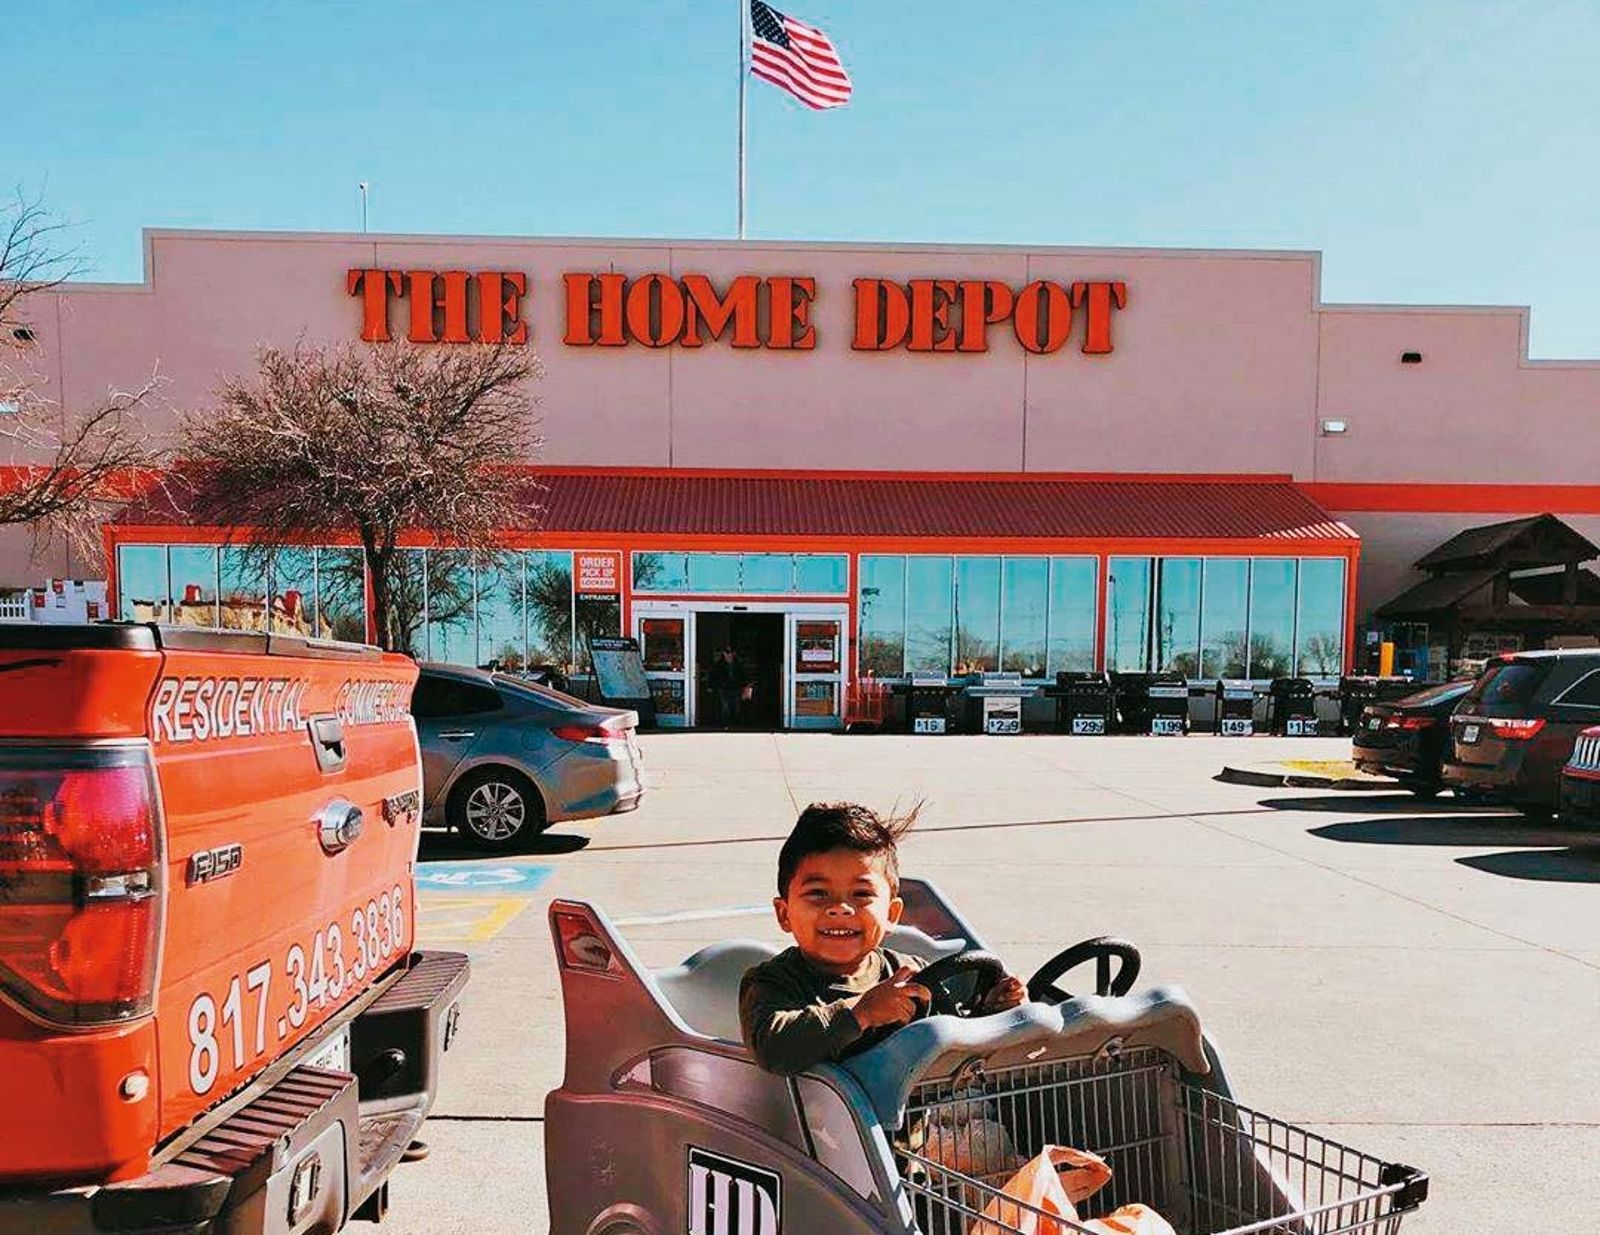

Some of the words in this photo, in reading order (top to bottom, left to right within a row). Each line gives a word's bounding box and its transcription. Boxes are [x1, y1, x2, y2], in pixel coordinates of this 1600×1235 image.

[347, 269, 527, 345] THE
[562, 273, 816, 350] HOME
[852, 278, 1126, 355] DEPOT
[579, 556, 615, 568] ORDER
[153, 676, 307, 744] RESIDENTIAL
[188, 885, 404, 1094] 817.343.3836
